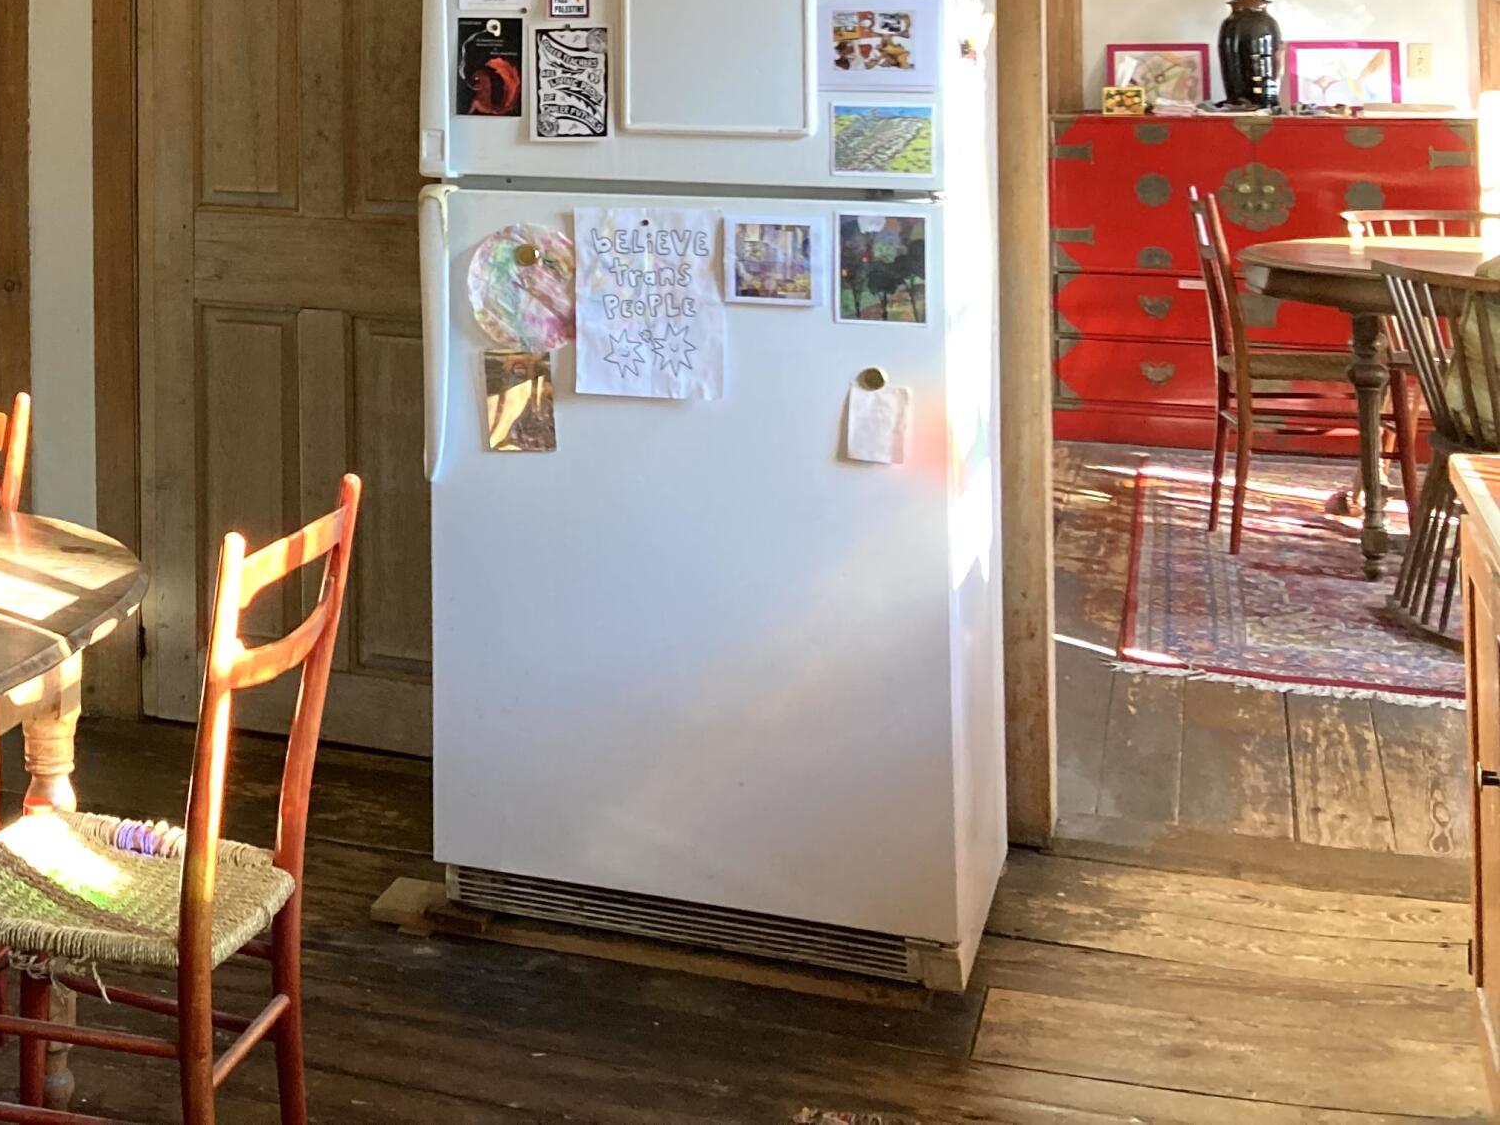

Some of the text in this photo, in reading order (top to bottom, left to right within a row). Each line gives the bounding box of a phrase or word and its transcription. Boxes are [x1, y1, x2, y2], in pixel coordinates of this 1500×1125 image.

[554, 5, 585, 13] PALESTINE
[563, 54, 598, 68] TEACHERS
[548, 76, 579, 88] LIVING
[543, 93, 556, 101] OF
[608, 257, 692, 287] trans
[602, 292, 697, 319] PEOPLE
